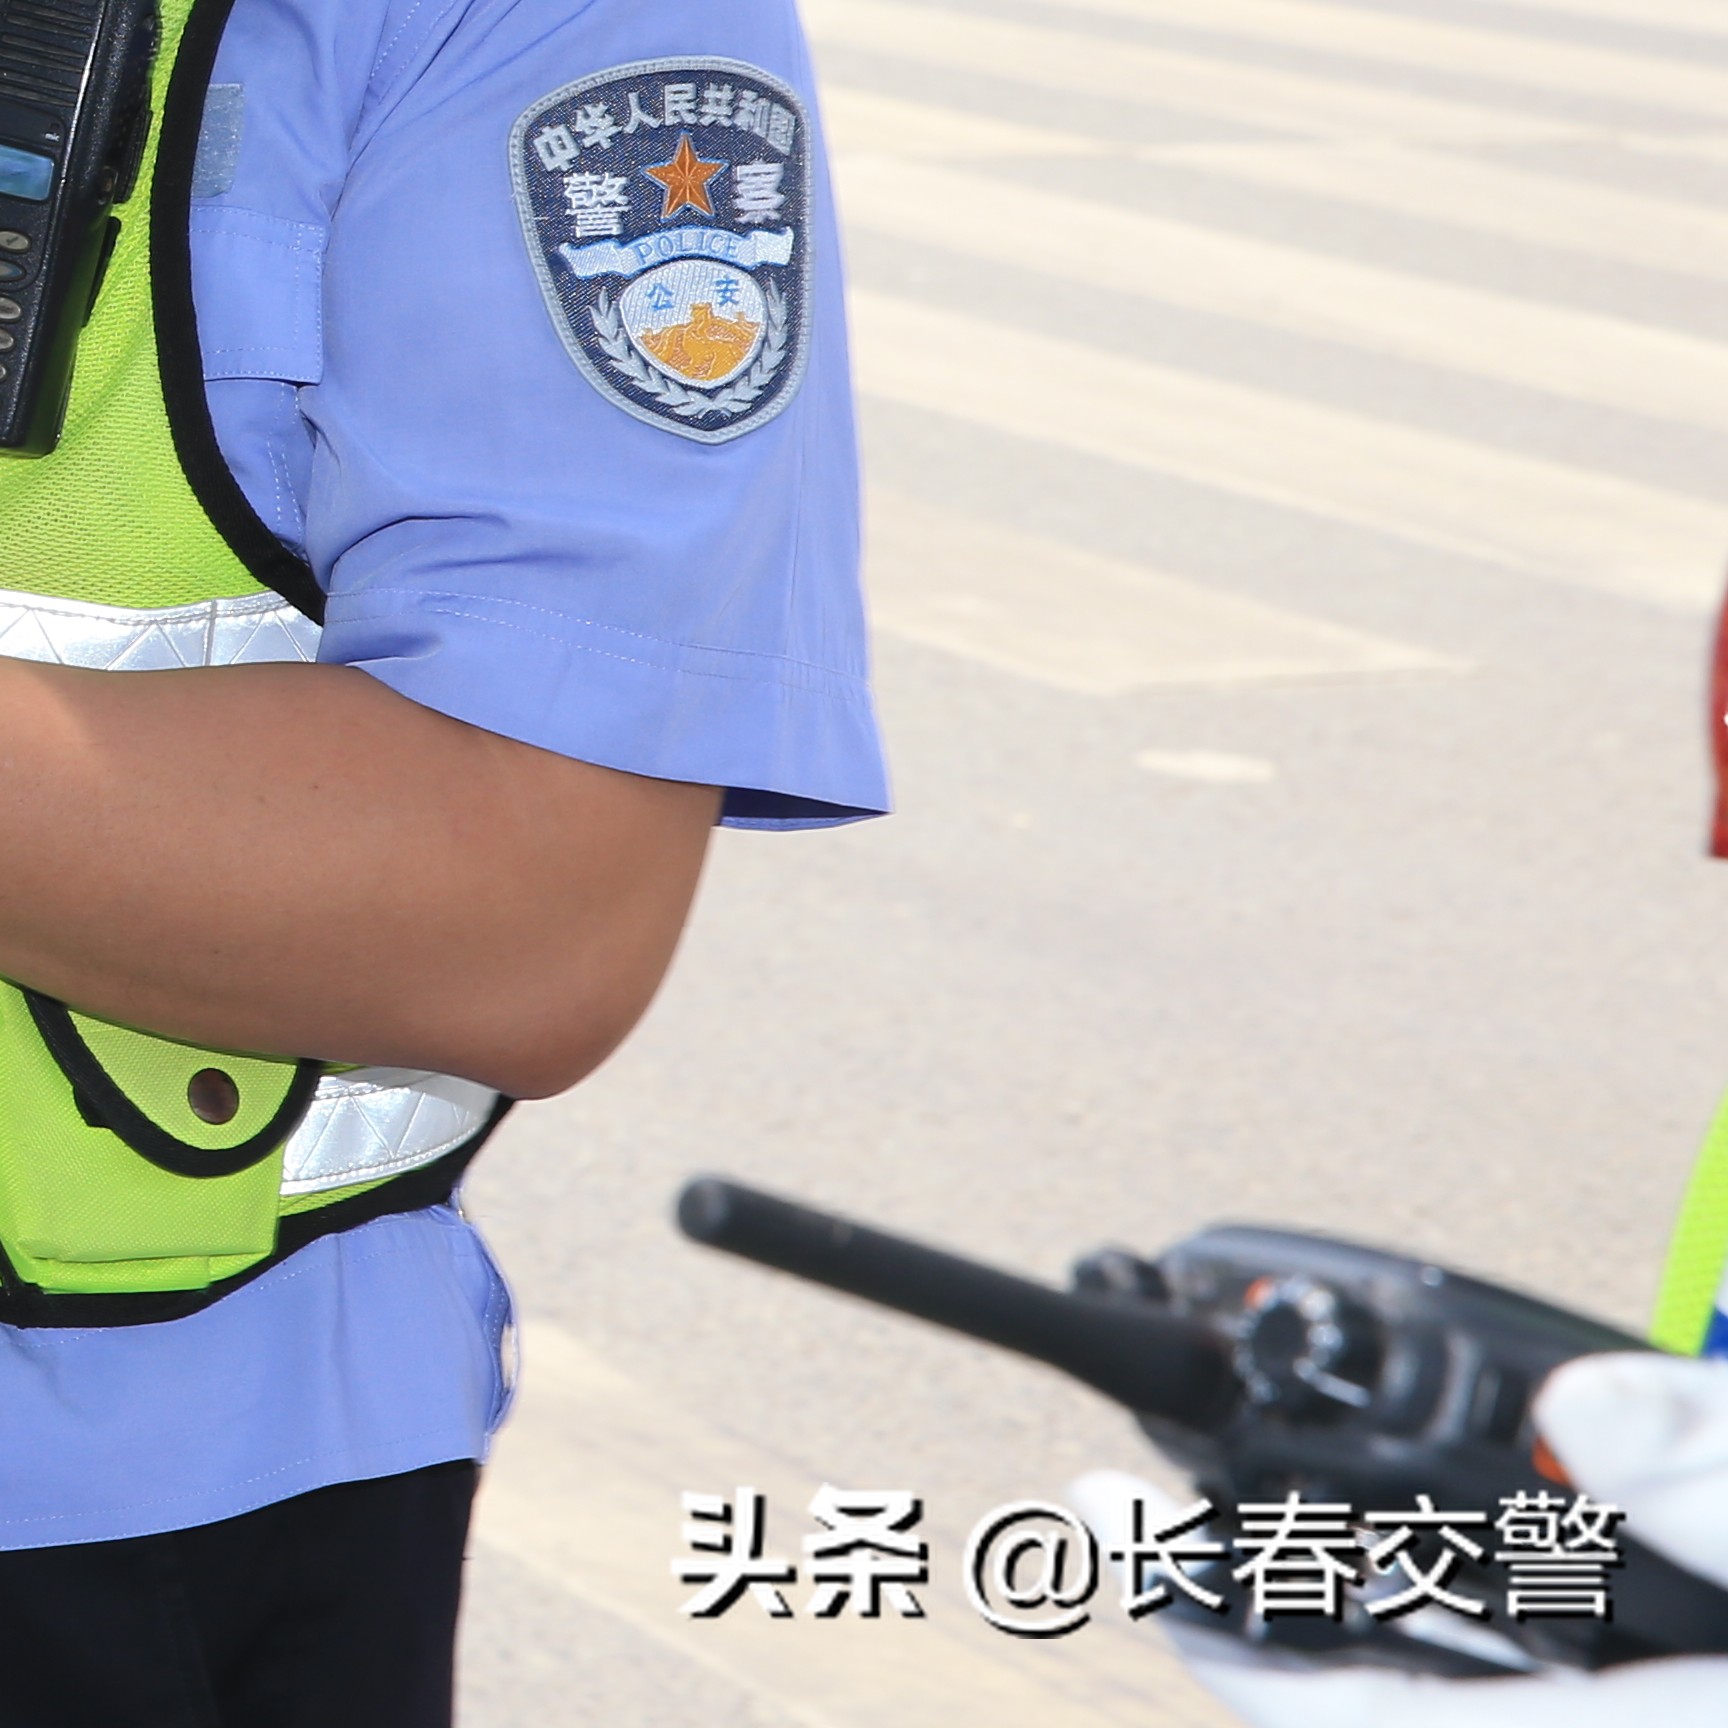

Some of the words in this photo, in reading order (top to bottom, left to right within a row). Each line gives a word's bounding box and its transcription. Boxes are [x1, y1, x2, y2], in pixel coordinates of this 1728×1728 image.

[44, 131, 61, 142] mic
[533, 82, 796, 172] 中华人民共和国
[633, 232, 740, 265] POLICE
